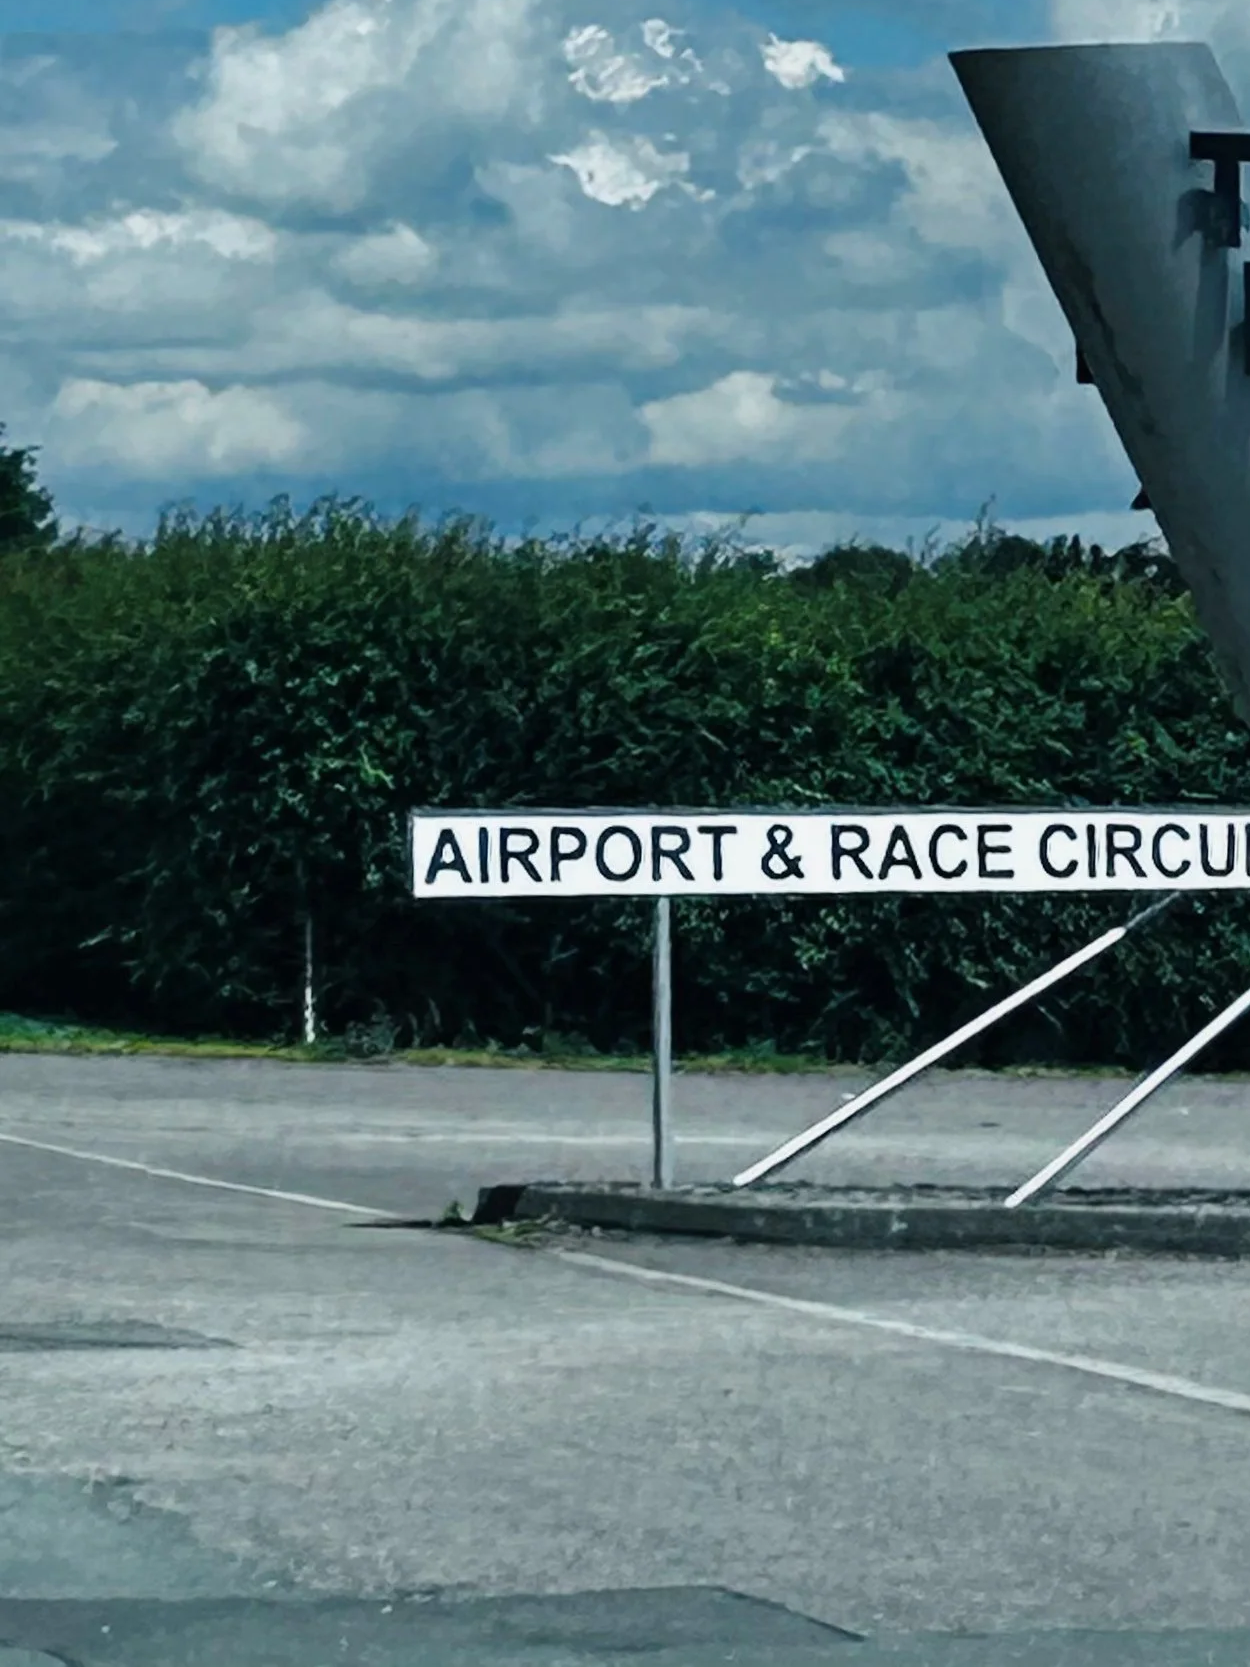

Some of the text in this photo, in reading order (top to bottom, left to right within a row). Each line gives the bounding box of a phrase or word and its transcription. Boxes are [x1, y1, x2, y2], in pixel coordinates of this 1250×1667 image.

[425, 825, 737, 884] AIRPORT
[761, 827, 805, 879] &
[831, 824, 1015, 880] RACE
